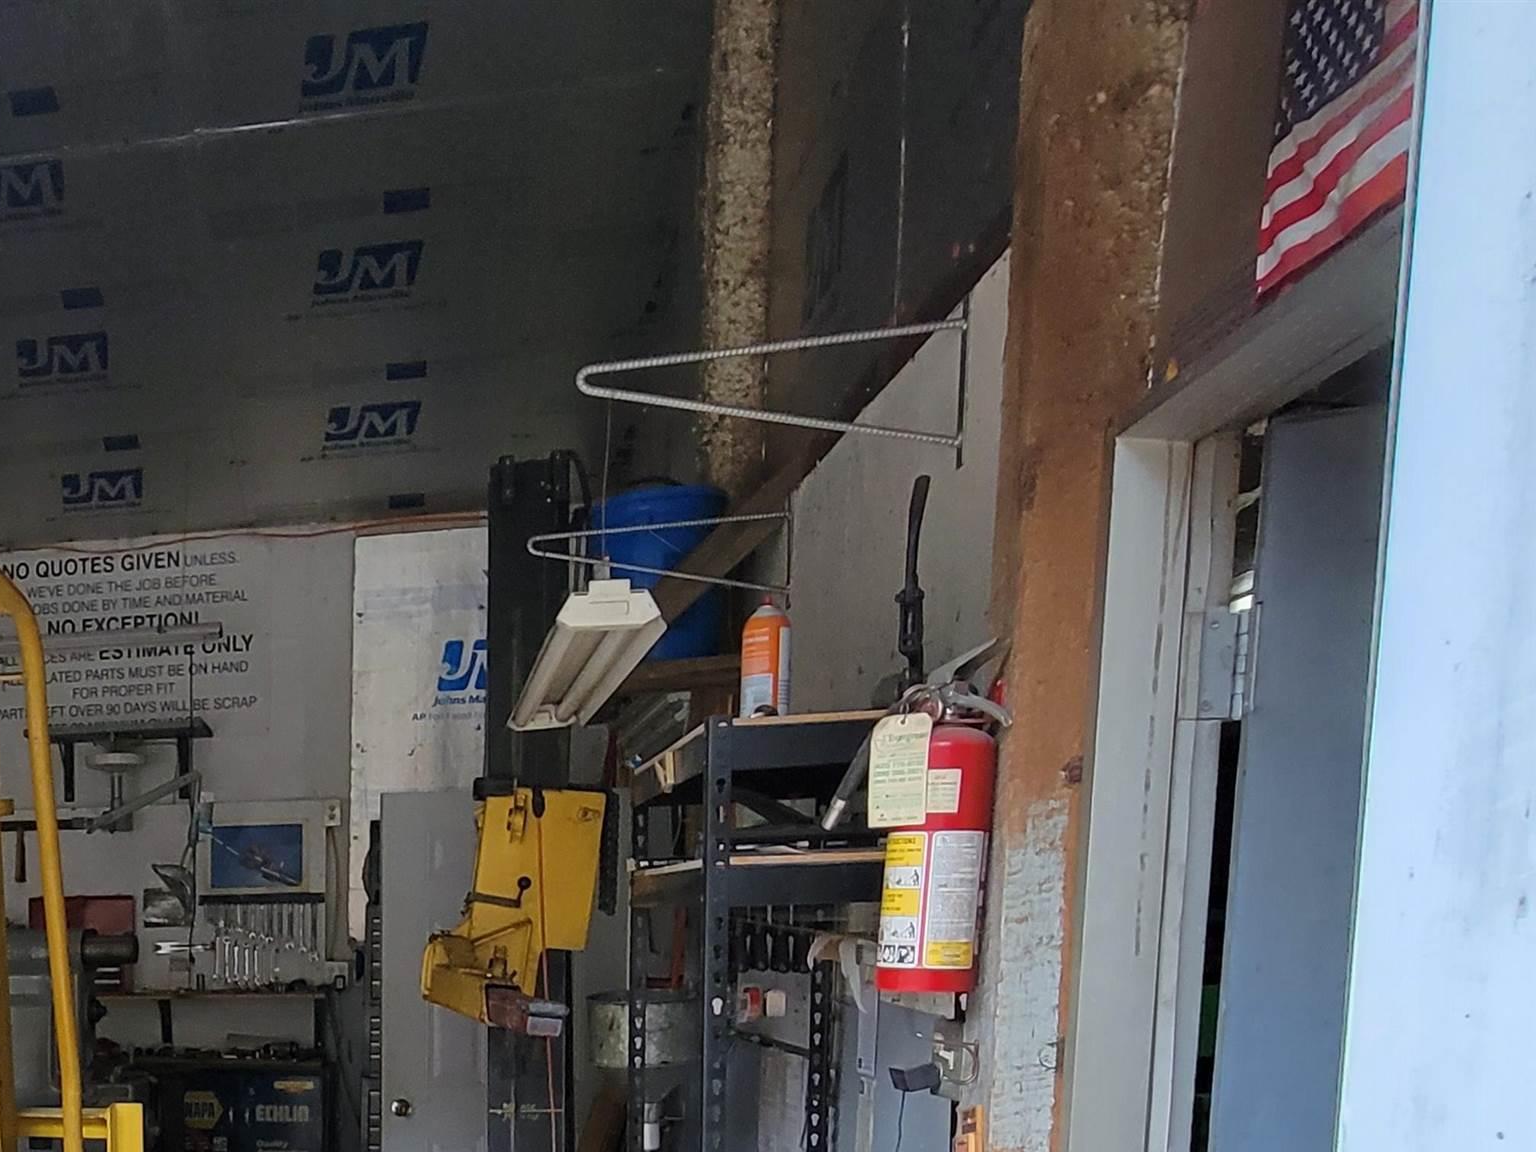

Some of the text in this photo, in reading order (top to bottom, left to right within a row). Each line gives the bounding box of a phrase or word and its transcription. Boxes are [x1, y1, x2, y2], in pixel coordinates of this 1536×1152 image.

[301, 24, 426, 97] JM
[314, 240, 423, 294] JM
[16, 331, 109, 378] JM
[324, 401, 421, 442] JM
[61, 467, 143, 504] JM
[3, 563, 29, 580] NO
[36, 556, 114, 579] QUOTES
[121, 551, 180, 571] GIVEN
[67, 582, 104, 597] DONE
[109, 579, 132, 593] THE
[135, 577, 161, 592] JOB
[164, 573, 216, 589] BEFORE
[31, 589, 248, 616] OBS DONE BY TIME AND MATERIAL
[48, 619, 76, 636] NO
[99, 644, 196, 661] ESTIMATE
[201, 634, 253, 655] ONLY
[85, 667, 124, 682] PARTS
[128, 664, 164, 679] MUST
[168, 663, 185, 677] BE
[189, 661, 208, 676] ON
[212, 660, 249, 674] HAND
[72, 681, 176, 699] FOR PROPER FIT
[46, 704, 65, 718] EFT
[68, 702, 104, 717] OVER
[106, 702, 120, 715] 90
[124, 699, 156, 714] DAYS
[159, 697, 189, 712] WILL
[192, 698, 208, 711] BE
[213, 695, 257, 710] SCRAP
